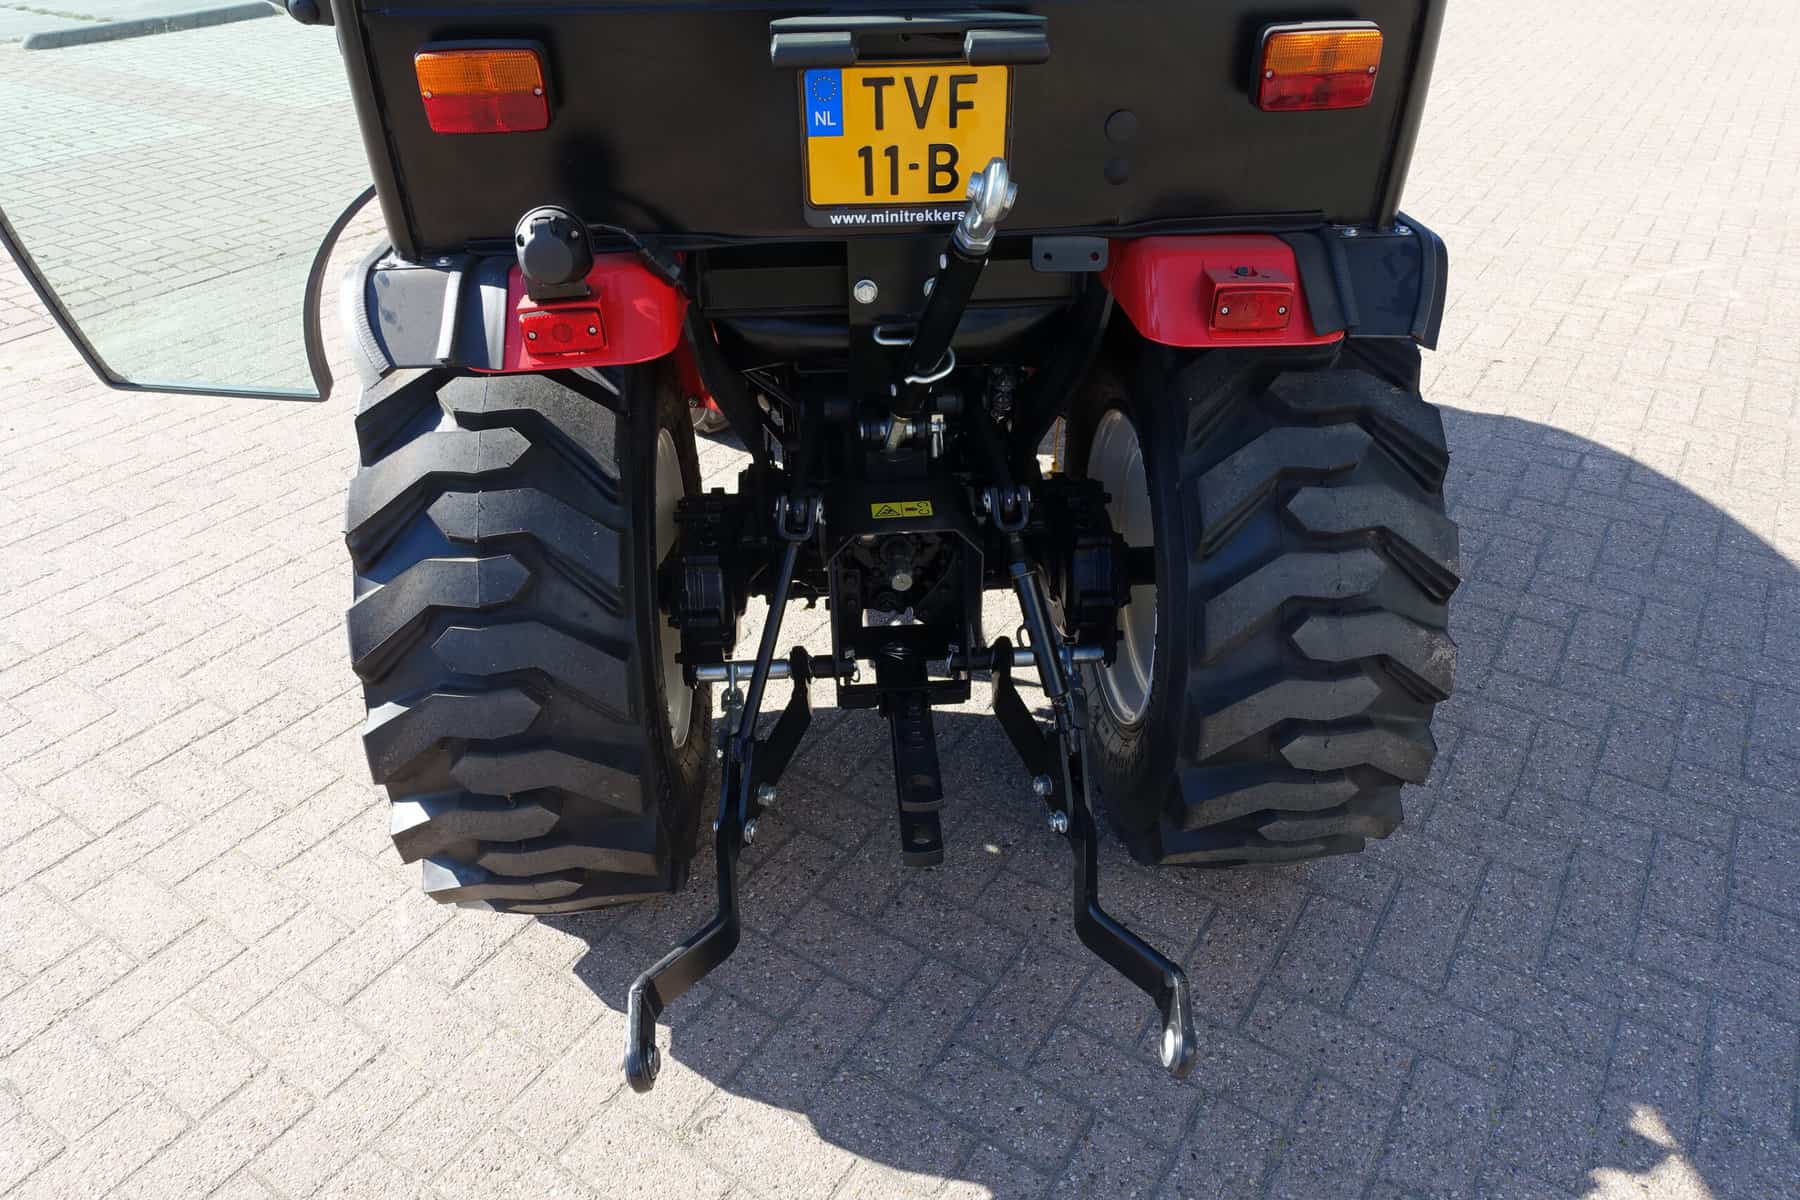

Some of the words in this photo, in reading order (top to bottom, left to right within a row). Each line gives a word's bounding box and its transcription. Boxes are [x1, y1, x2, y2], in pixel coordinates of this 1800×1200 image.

[814, 111, 836, 127] NL
[862, 74, 978, 130] TVF
[857, 144, 960, 196] 11-B
